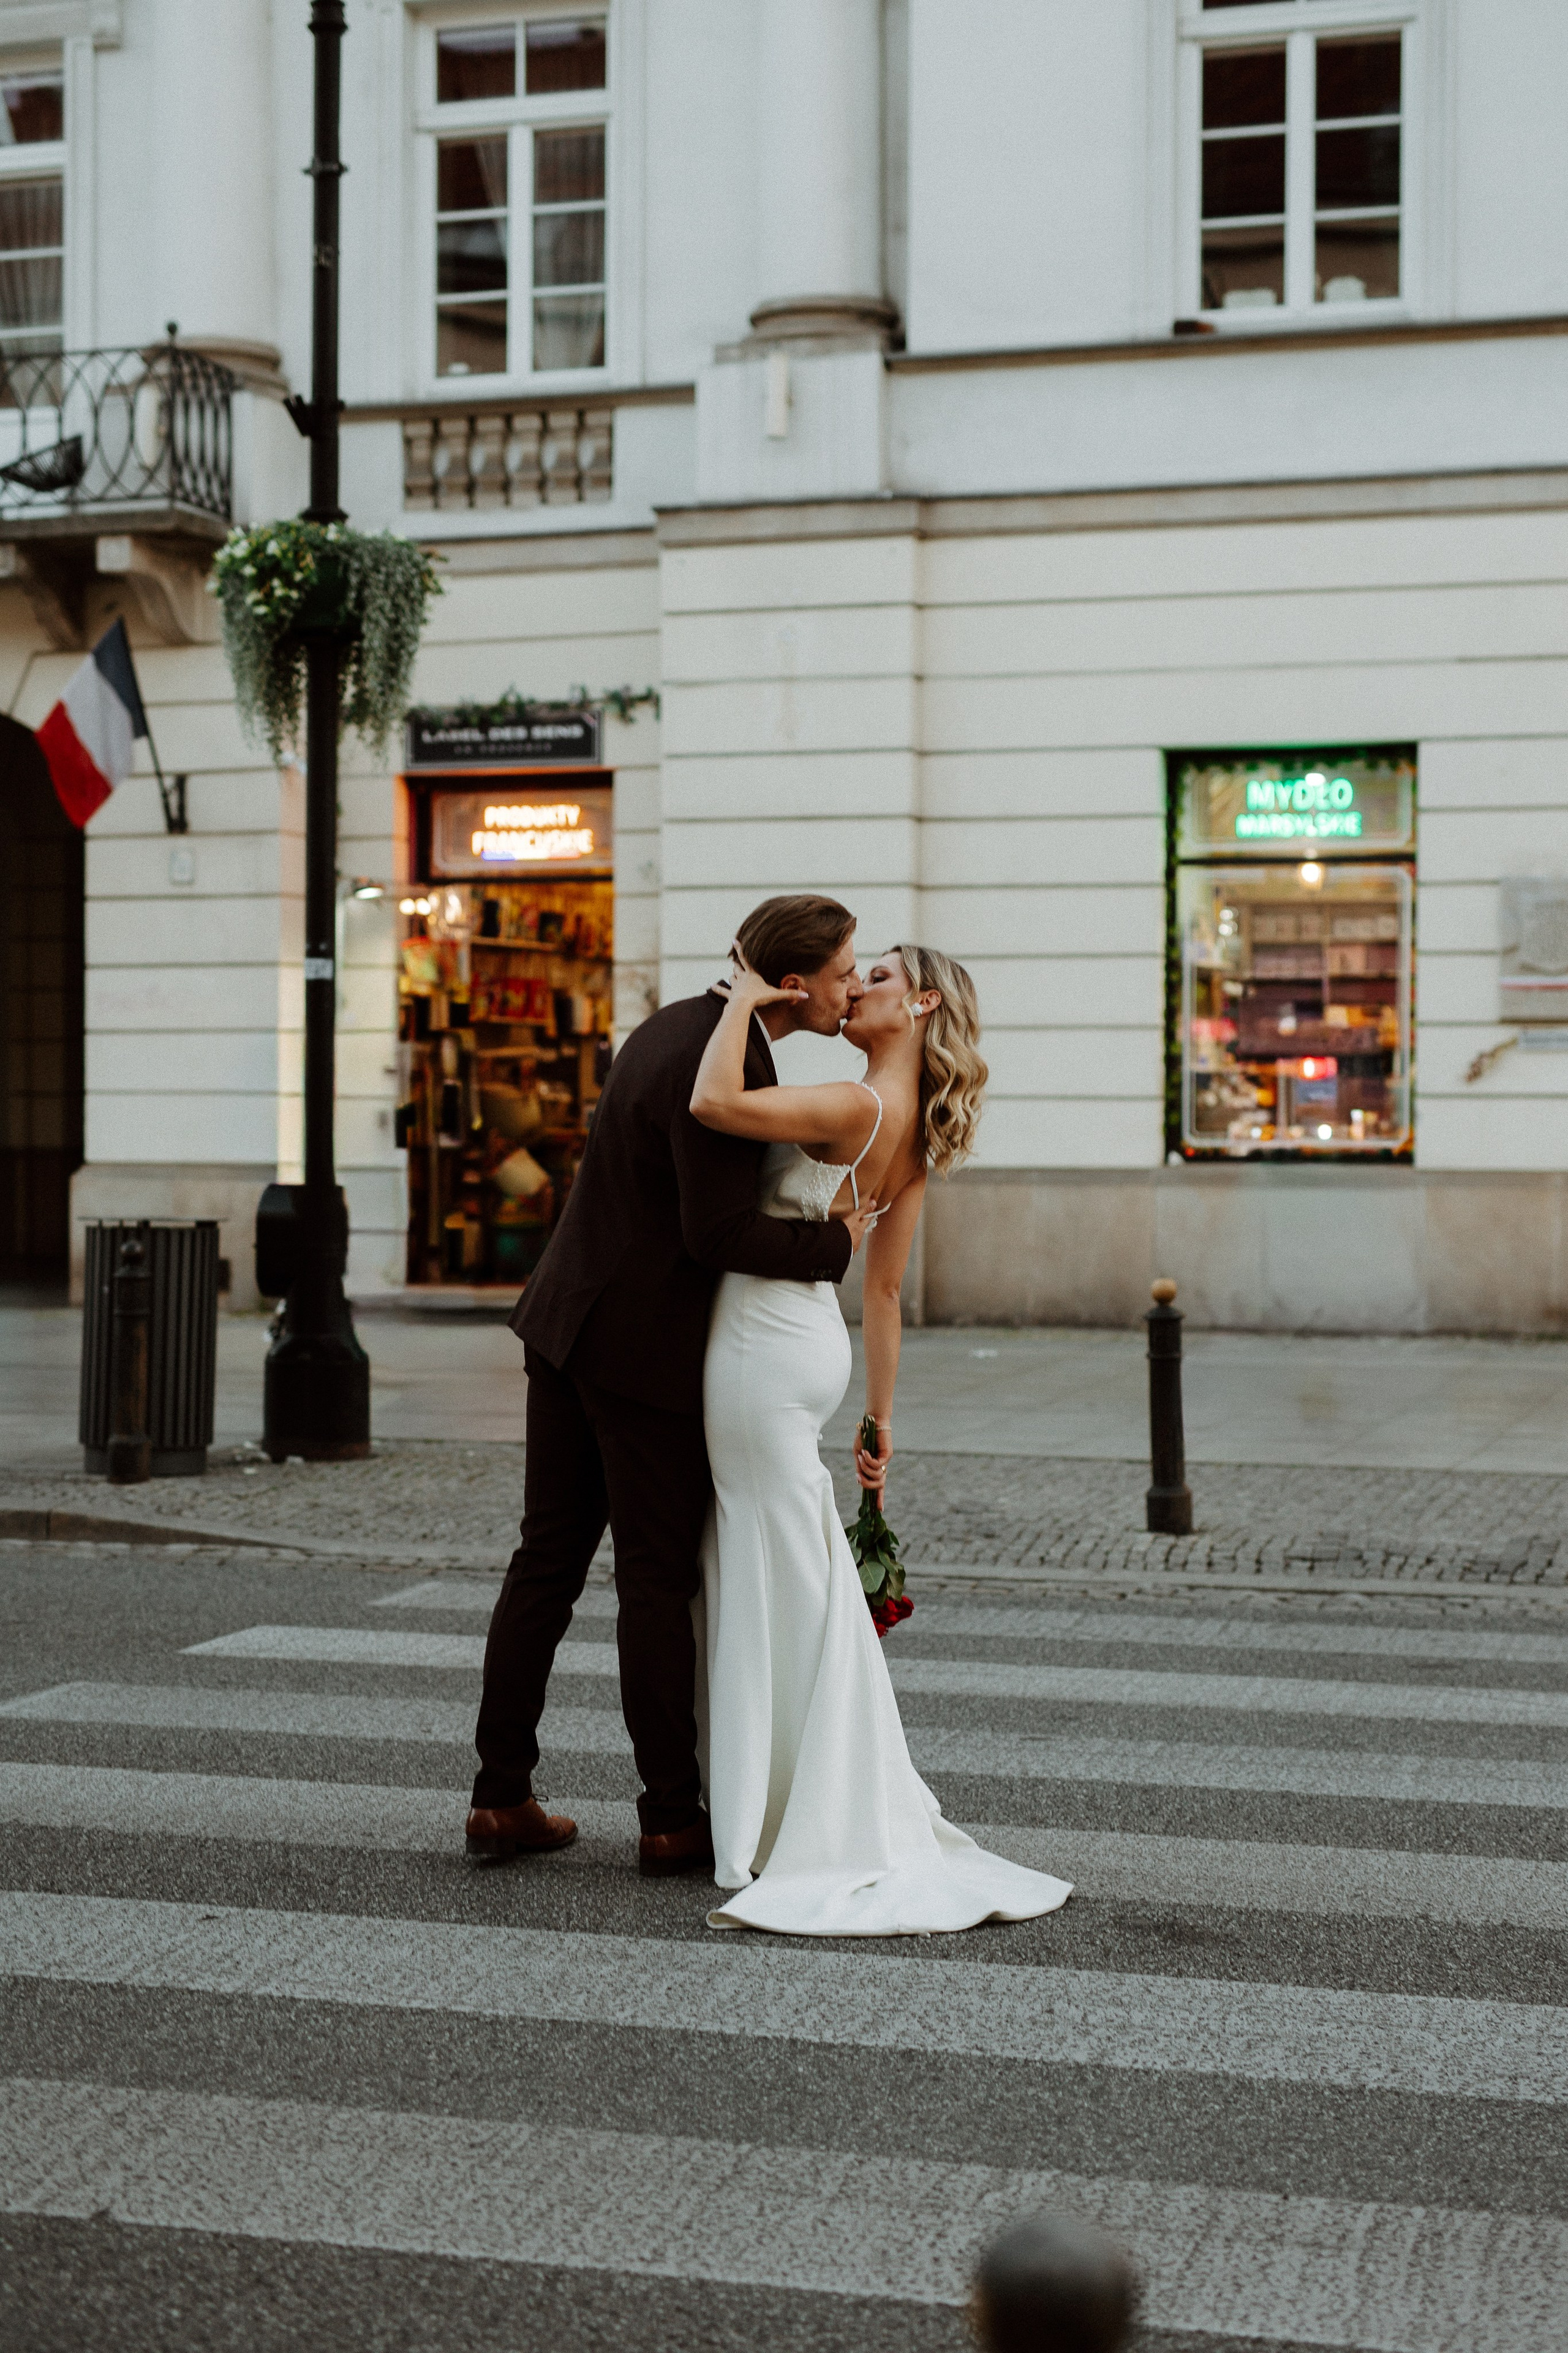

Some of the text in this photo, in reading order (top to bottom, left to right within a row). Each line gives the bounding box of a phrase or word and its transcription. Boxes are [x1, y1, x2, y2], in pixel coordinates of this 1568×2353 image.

[488, 725, 527, 741] DES
[530, 723, 584, 739] SENS
[484, 804, 581, 829] PRODUKTY
